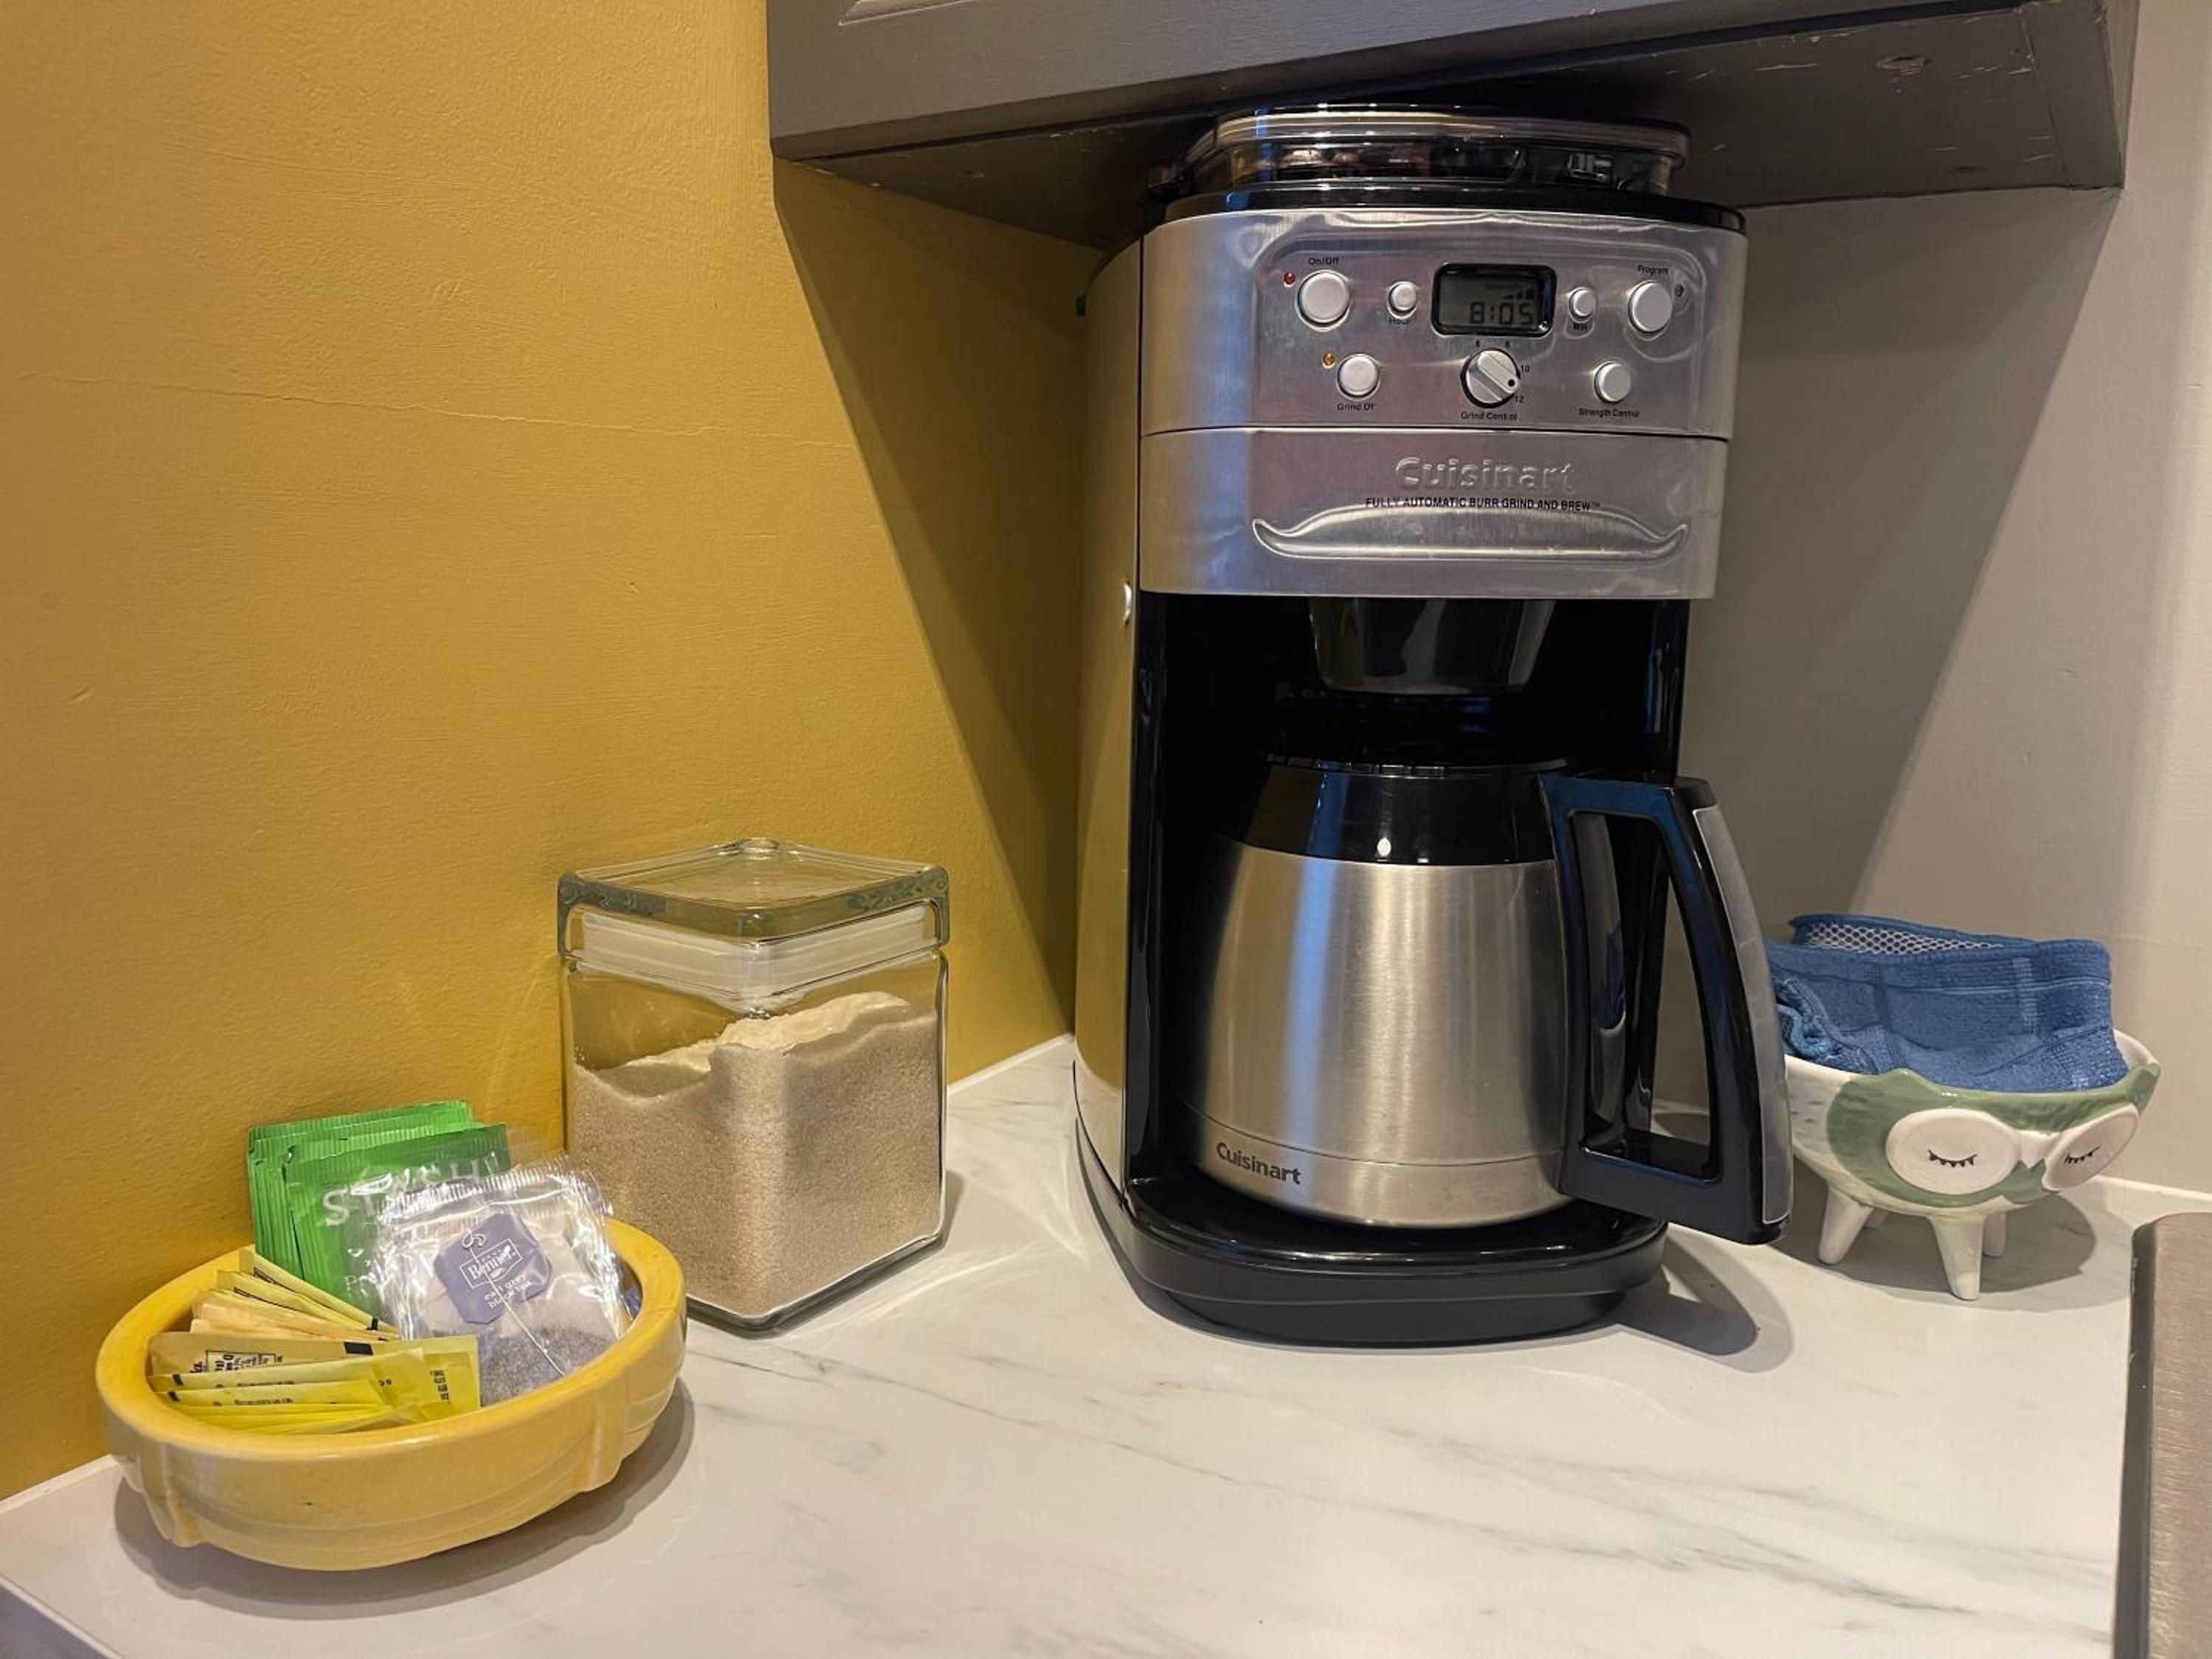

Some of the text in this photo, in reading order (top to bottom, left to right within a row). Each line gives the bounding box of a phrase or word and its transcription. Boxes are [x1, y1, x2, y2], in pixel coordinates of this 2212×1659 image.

[1470, 302, 1533, 326] 8:05
[1336, 403, 1362, 411] Grind
[1514, 394, 1524, 403] 12
[1395, 456, 1576, 495] Cuisinart
[1366, 498, 1400, 508] FULLY
[1403, 497, 1467, 508] AUTOMATIC
[1469, 498, 1499, 508] BURR
[1501, 498, 1534, 509] GRIND
[1537, 499, 1557, 509] AND
[1217, 1141, 1301, 1185] Cuisinart
[322, 1158, 484, 1227] STSH
[484, 1284, 503, 1301] eal
